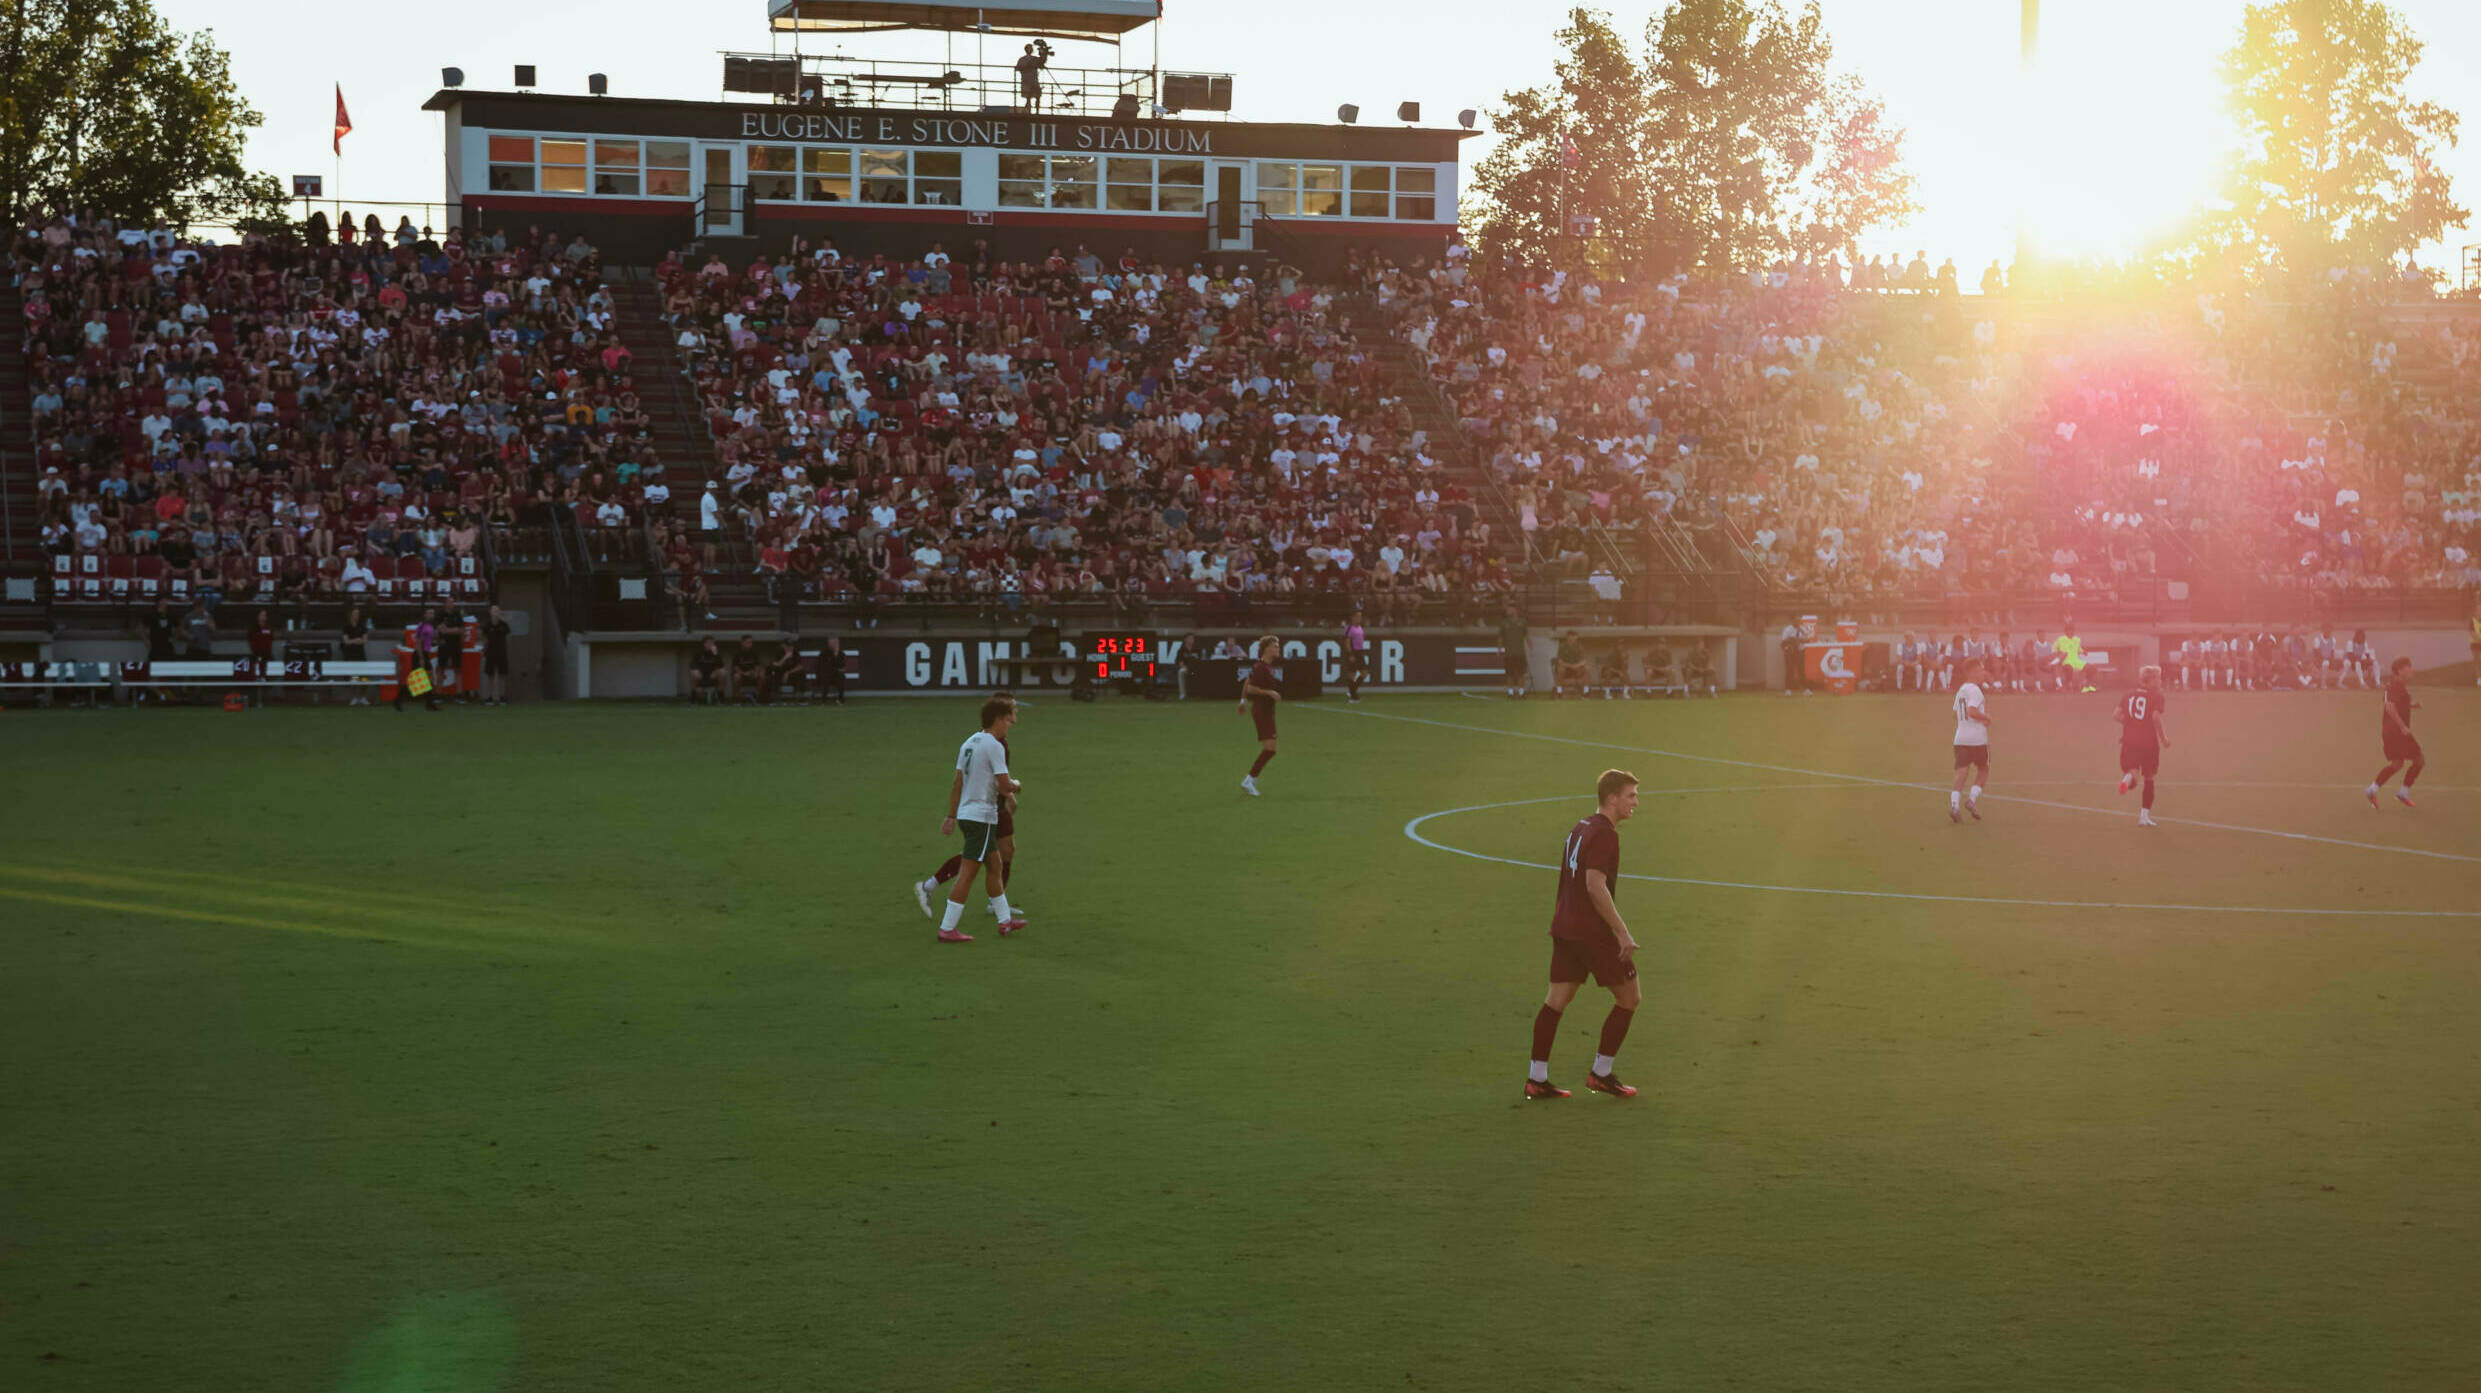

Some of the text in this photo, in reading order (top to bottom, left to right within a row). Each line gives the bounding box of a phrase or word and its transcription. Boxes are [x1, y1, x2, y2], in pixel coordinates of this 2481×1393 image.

[741, 113, 1213, 152] EUGENE E. STONE III STADIUM
[1098, 662, 1154, 677] 0 1
[2129, 696, 2147, 720] 19
[1566, 832, 1583, 878] 14
